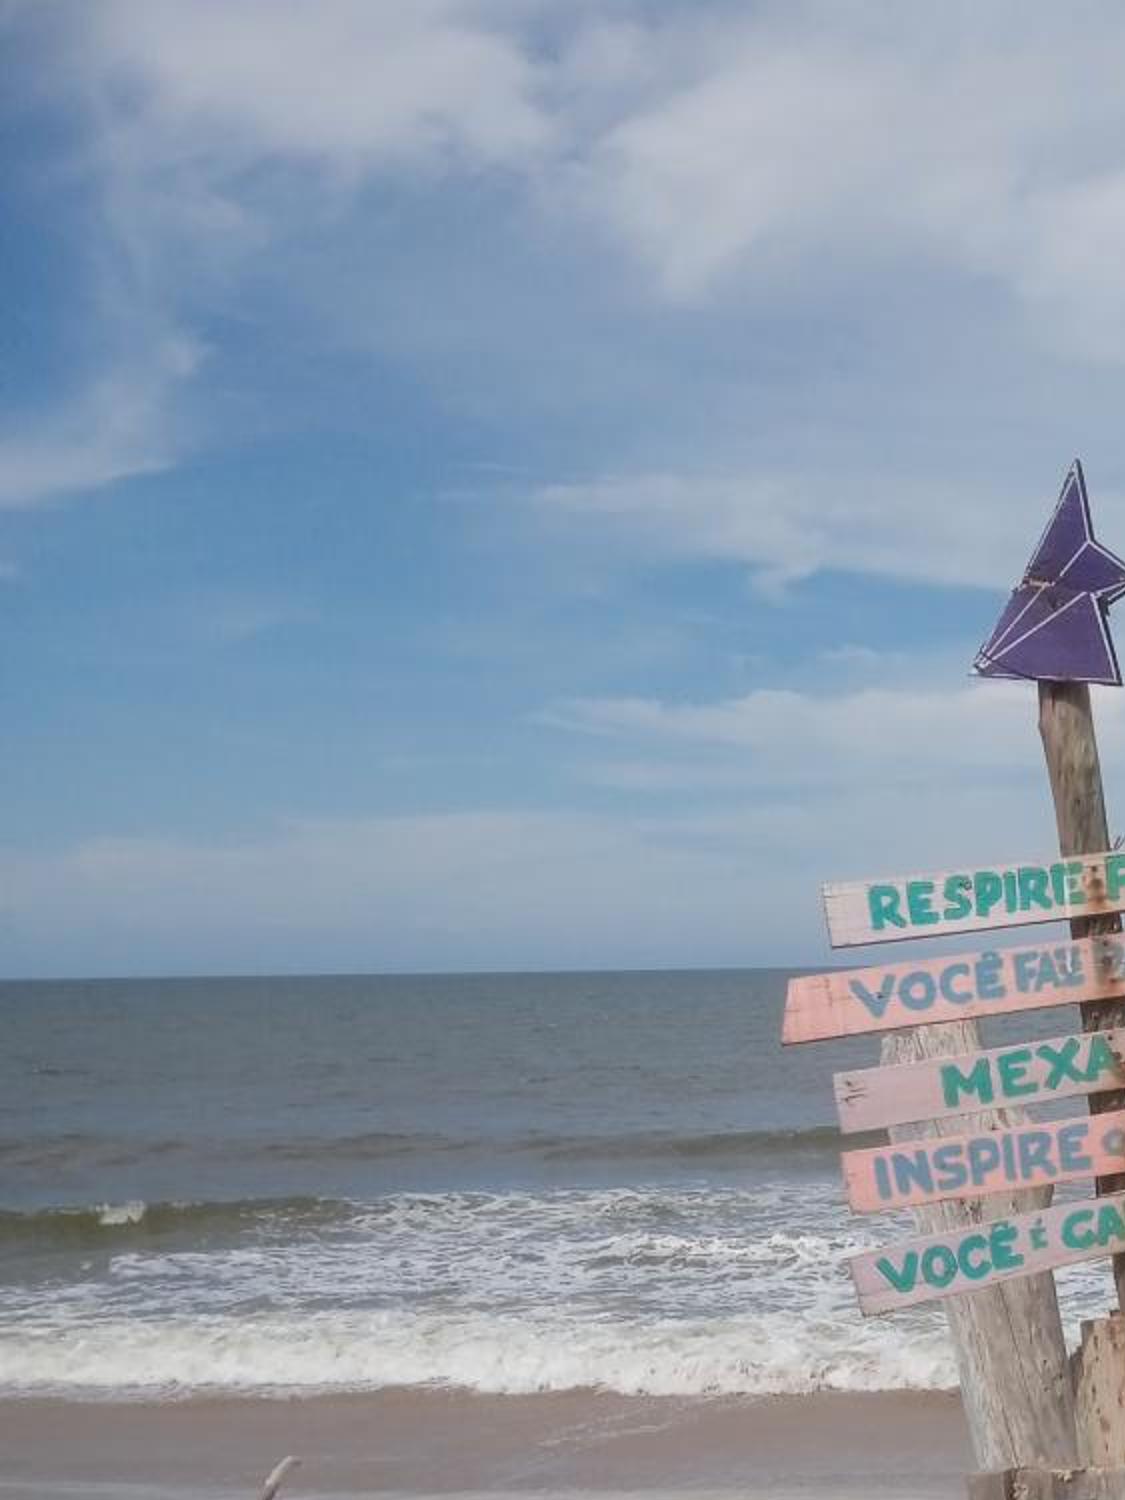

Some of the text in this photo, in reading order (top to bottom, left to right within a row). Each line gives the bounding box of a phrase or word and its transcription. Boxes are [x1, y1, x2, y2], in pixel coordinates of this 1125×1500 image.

[868, 862, 1085, 930] RESPIRE
[848, 951, 1006, 1019] VOCÊ
[873, 1123, 1093, 1202] INSPIRE
[874, 1219, 1025, 1294] VOCÊ
